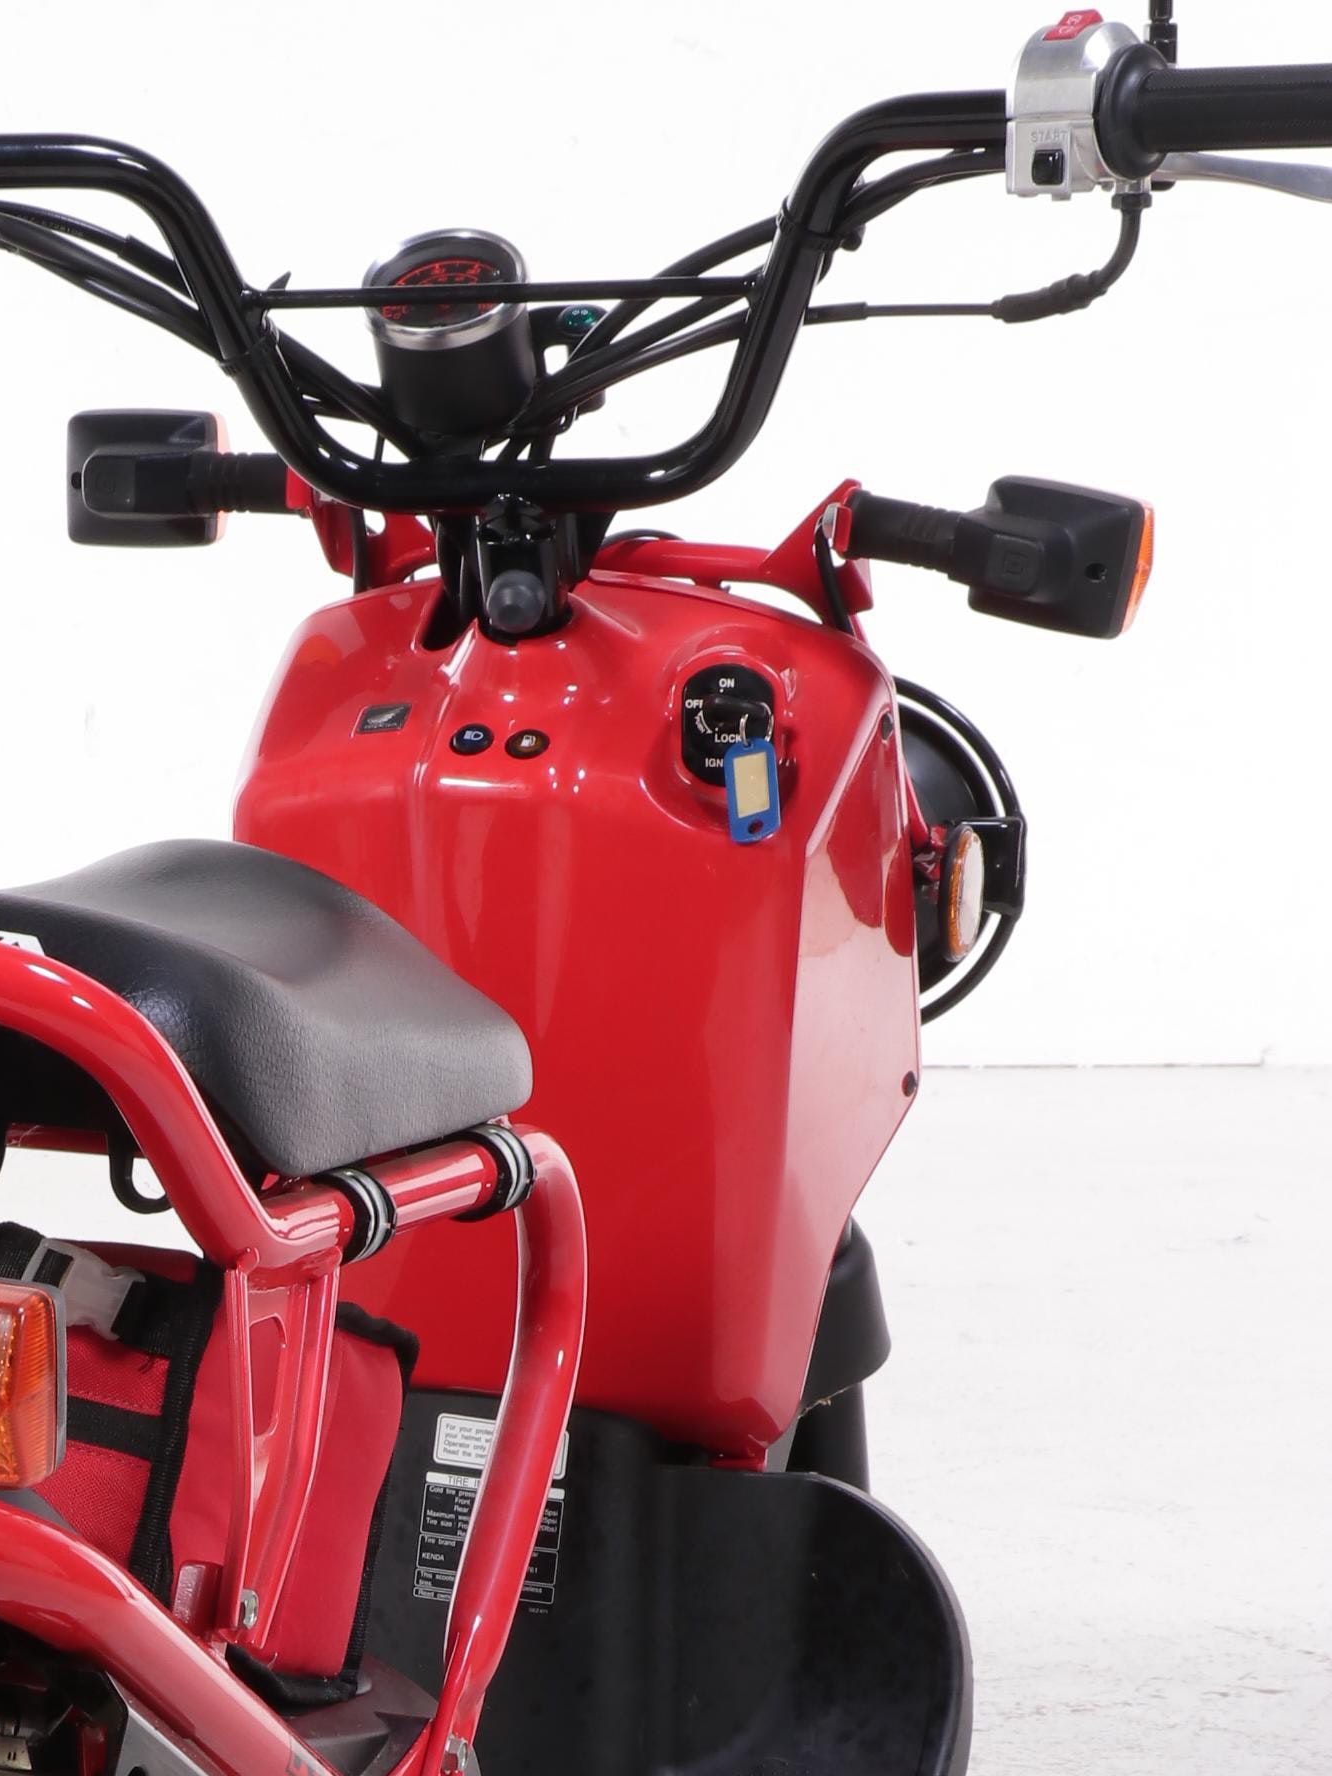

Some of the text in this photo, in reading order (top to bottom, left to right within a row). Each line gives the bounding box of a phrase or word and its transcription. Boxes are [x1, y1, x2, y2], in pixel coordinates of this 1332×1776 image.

[719, 678, 735, 688] ON
[714, 733, 742, 743] LOCK
[705, 758, 724, 768] IGN
[448, 1475, 469, 1487] TIRE
[421, 1552, 445, 1561] KENDA
